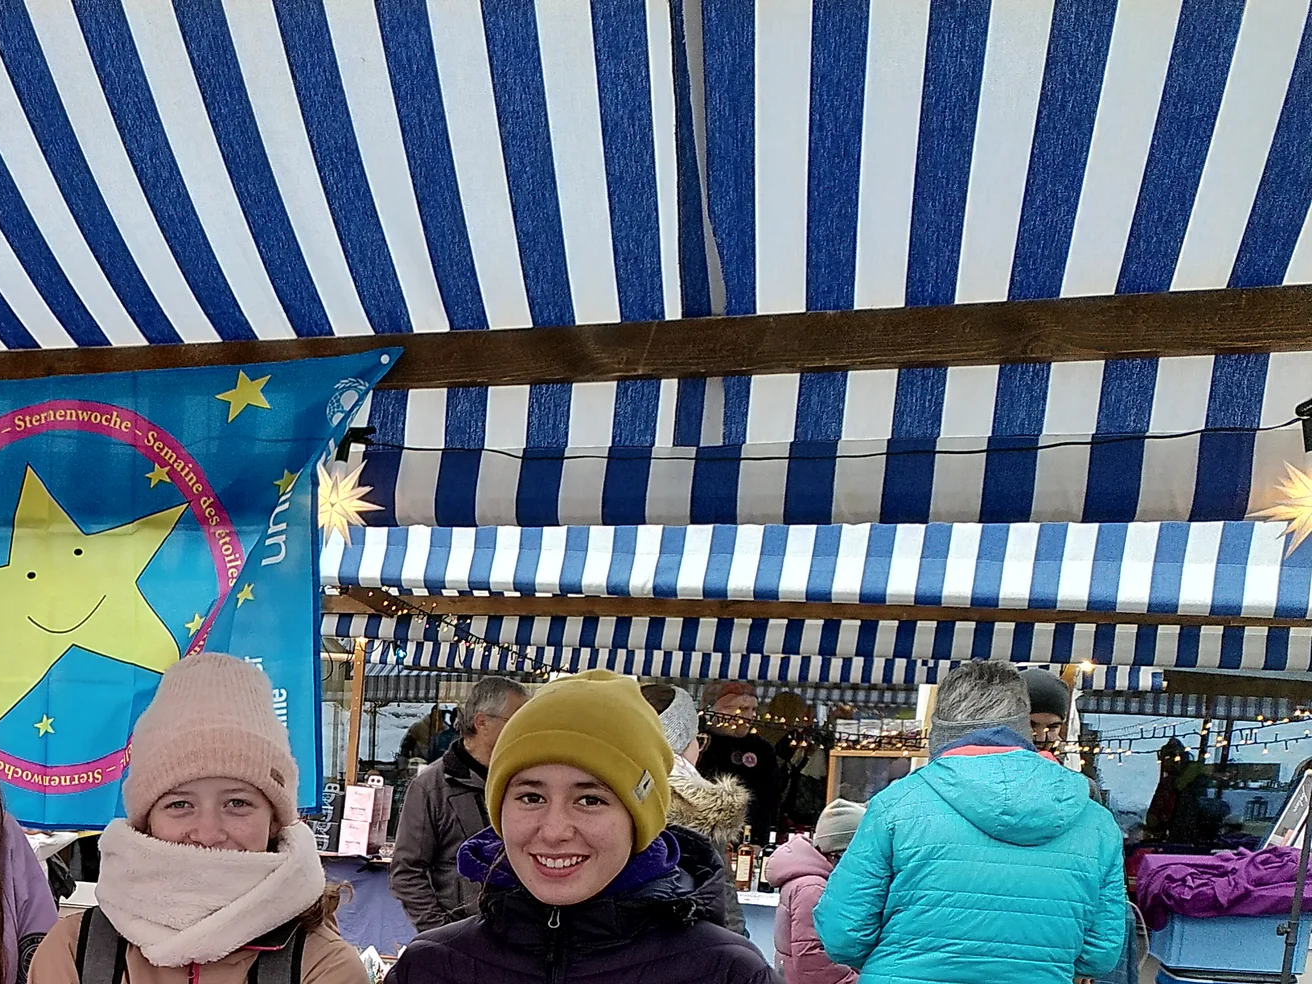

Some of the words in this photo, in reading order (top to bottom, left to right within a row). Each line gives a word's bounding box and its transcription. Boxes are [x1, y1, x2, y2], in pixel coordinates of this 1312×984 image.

[13, 408, 133, 433] Sternenwoche
[144, 431, 204, 495] Semaine
[200, 496, 221, 526] des
